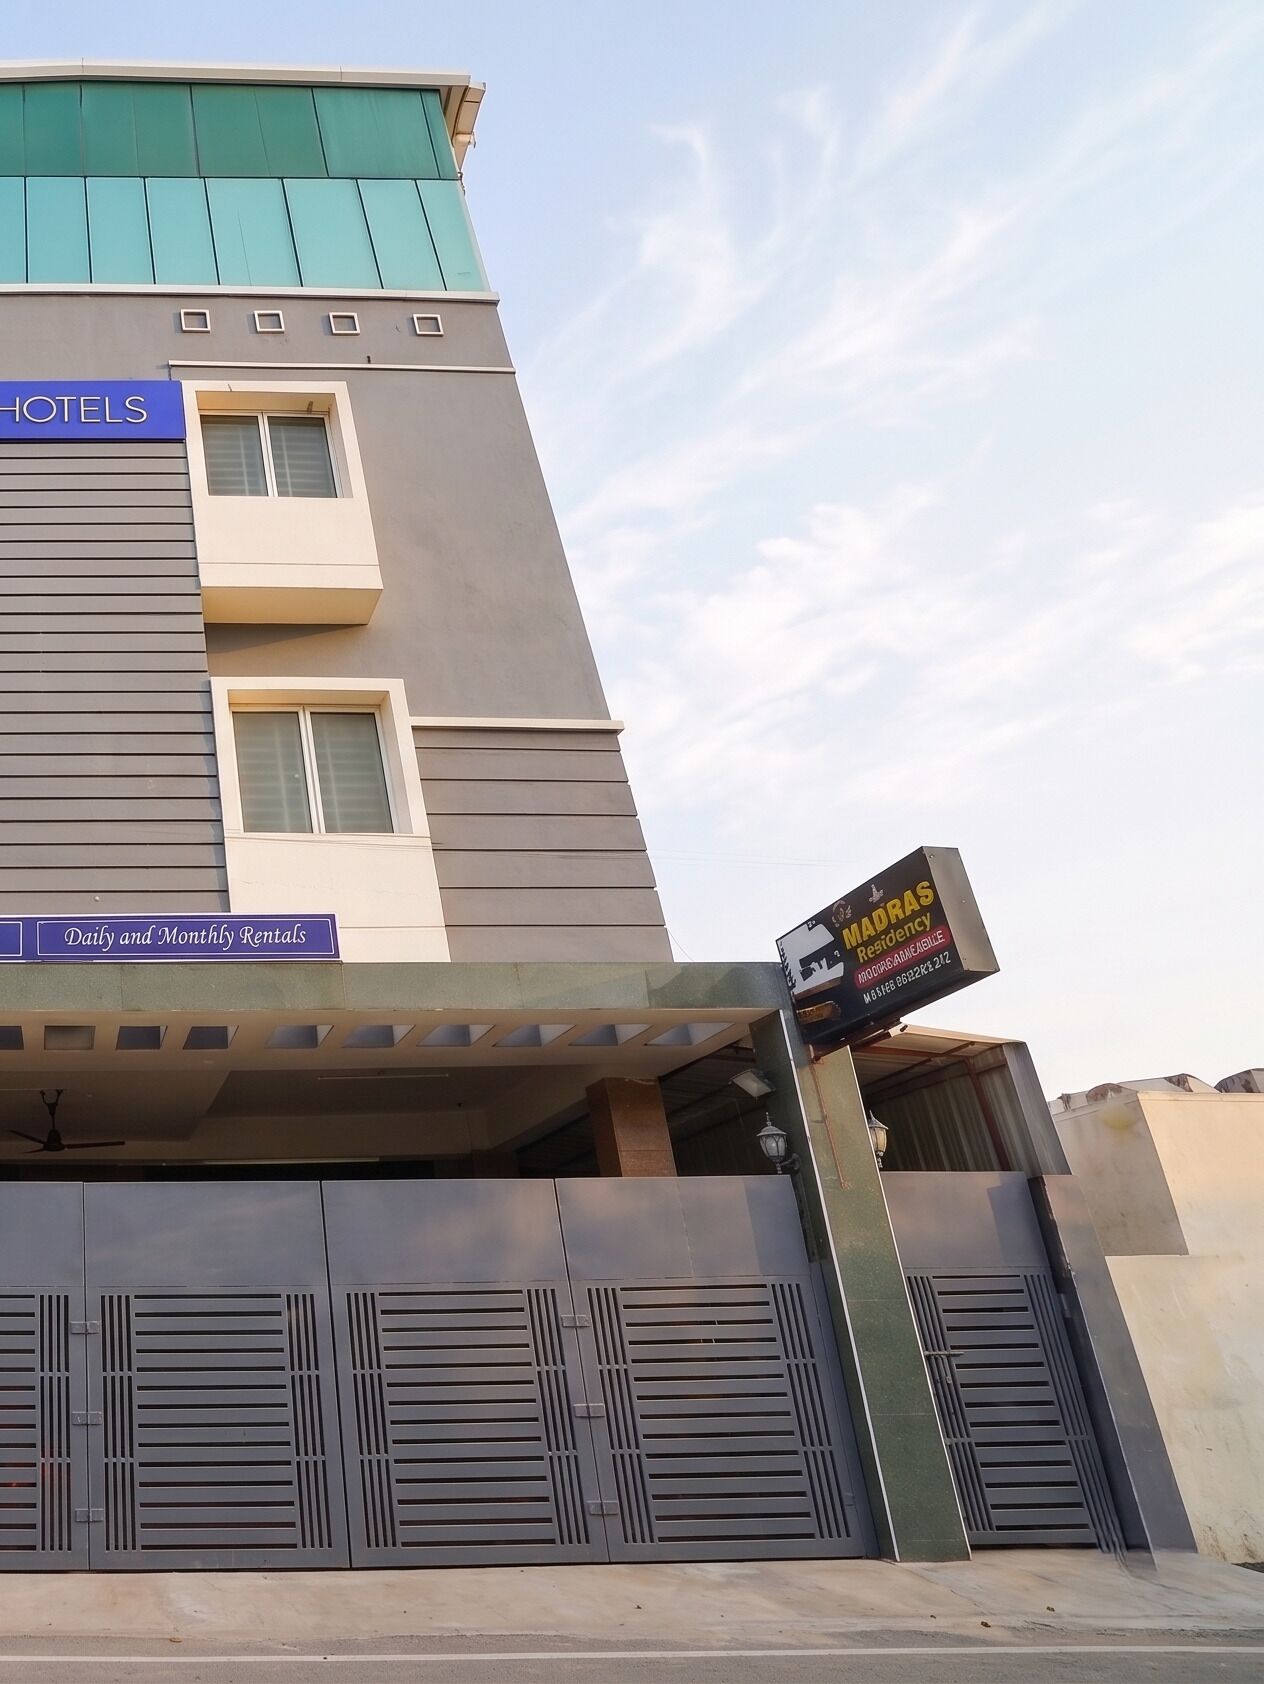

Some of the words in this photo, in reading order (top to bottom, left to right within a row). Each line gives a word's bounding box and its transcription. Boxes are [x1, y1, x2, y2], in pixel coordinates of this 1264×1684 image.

[63, 925, 116, 952] Daily
[119, 924, 157, 946] and
[158, 924, 235, 951] Monthly
[239, 923, 307, 948] Rentals
[841, 881, 934, 951] MADRAS
[856, 912, 932, 964] Residency
